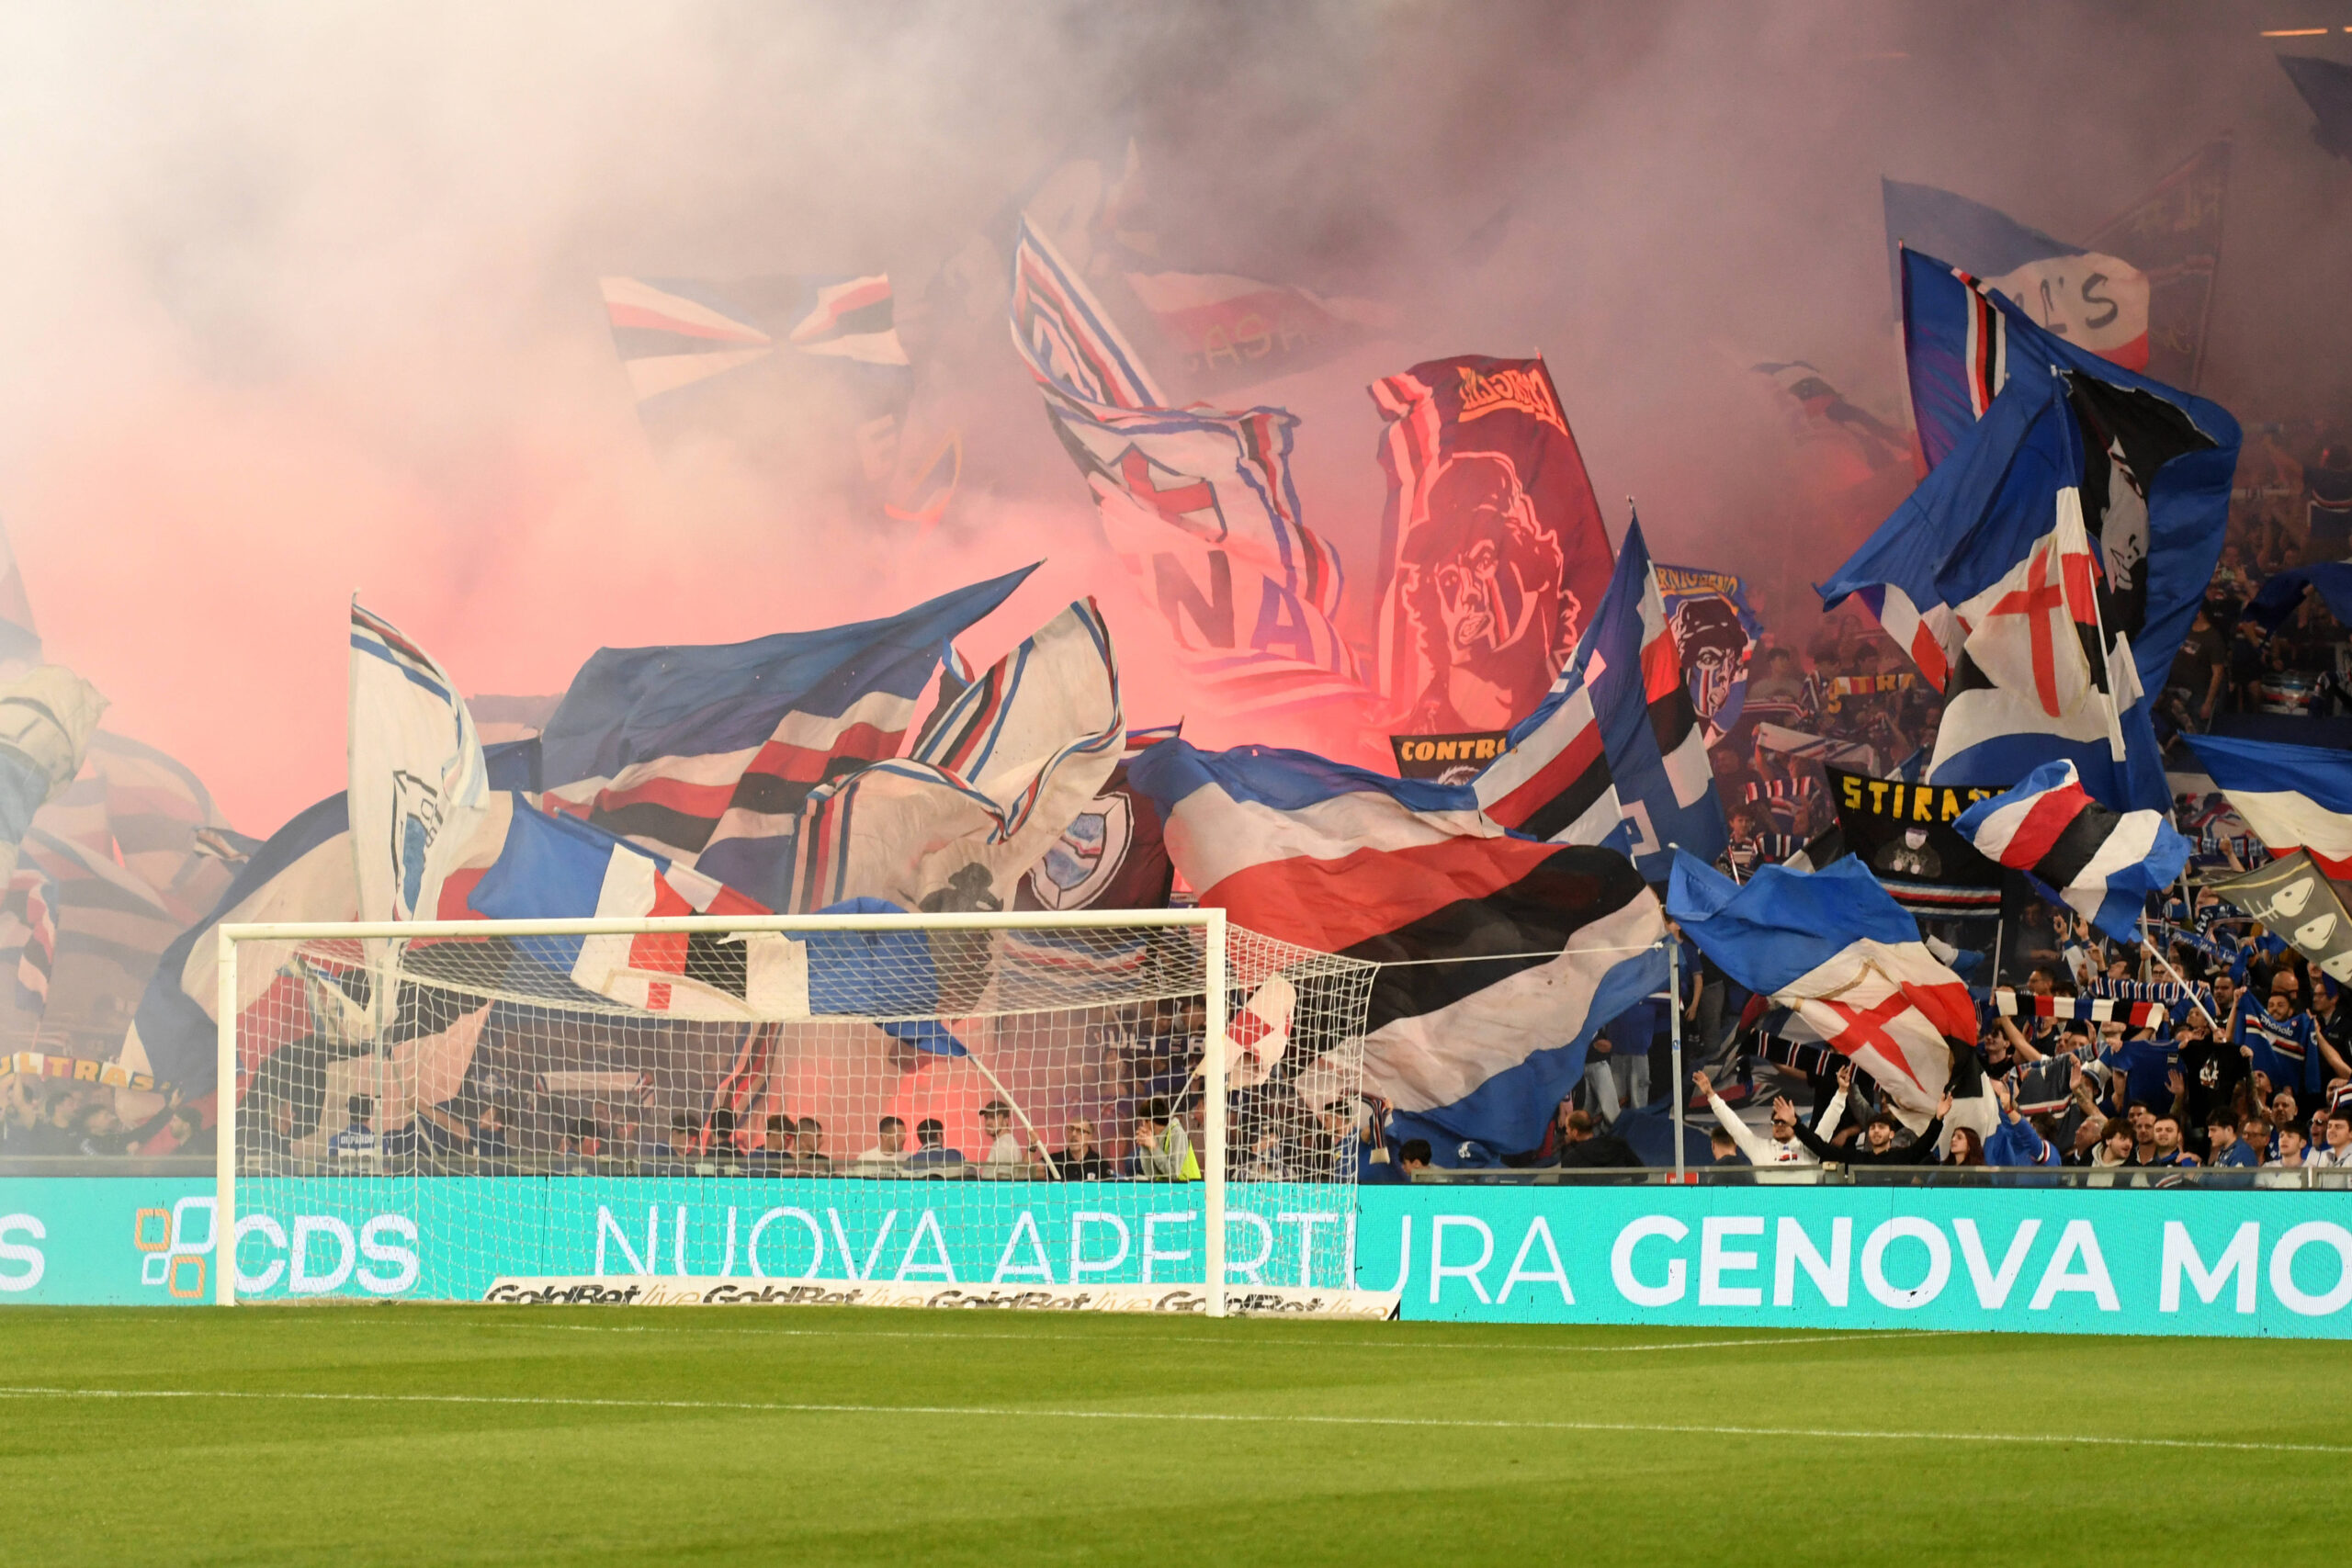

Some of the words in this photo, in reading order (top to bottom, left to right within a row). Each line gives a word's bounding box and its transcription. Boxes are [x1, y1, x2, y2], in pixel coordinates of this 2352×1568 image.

[233, 1213, 418, 1294] CDS
[594, 1204, 956, 1283] NUOVA
[1610, 1213, 2121, 1312] GENOVA
